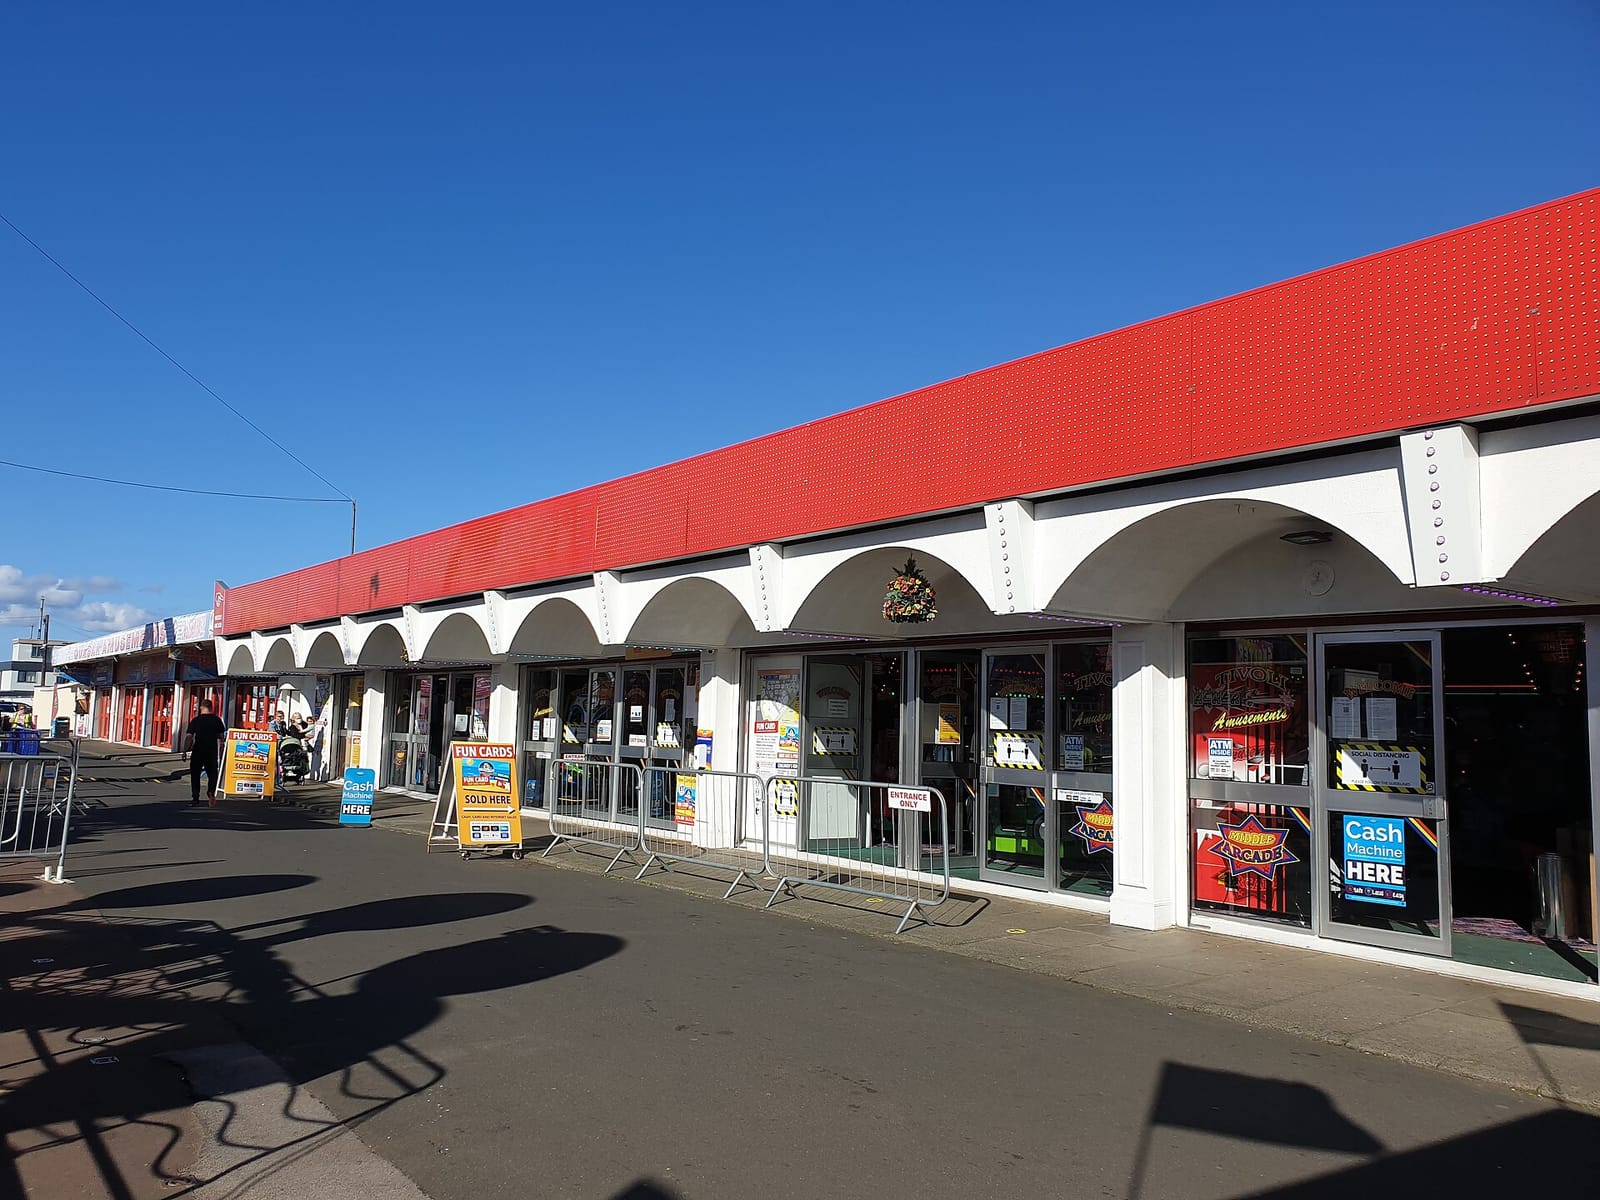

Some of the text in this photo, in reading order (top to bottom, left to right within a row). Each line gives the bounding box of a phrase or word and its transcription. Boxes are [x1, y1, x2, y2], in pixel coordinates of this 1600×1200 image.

[1215, 667, 1289, 690] TIVOLI
[1344, 680, 1416, 700] WELCOME
[1212, 708, 1287, 731] Amusements
[249, 733, 273, 741] CARDS
[1210, 740, 1232, 749] ATM
[456, 746, 513, 758] FUN CARDS
[344, 781, 374, 791] Cash
[465, 795, 511, 804] SOLD HERE
[890, 791, 927, 801] ENTRANCE
[342, 805, 370, 814] HERE
[900, 800, 918, 808] ONLY
[1229, 831, 1275, 845] MIDDLE
[1346, 821, 1402, 843] Cash
[1222, 842, 1282, 862] ARCADE
[1347, 842, 1402, 858] Machine
[1347, 861, 1403, 884] HERE
